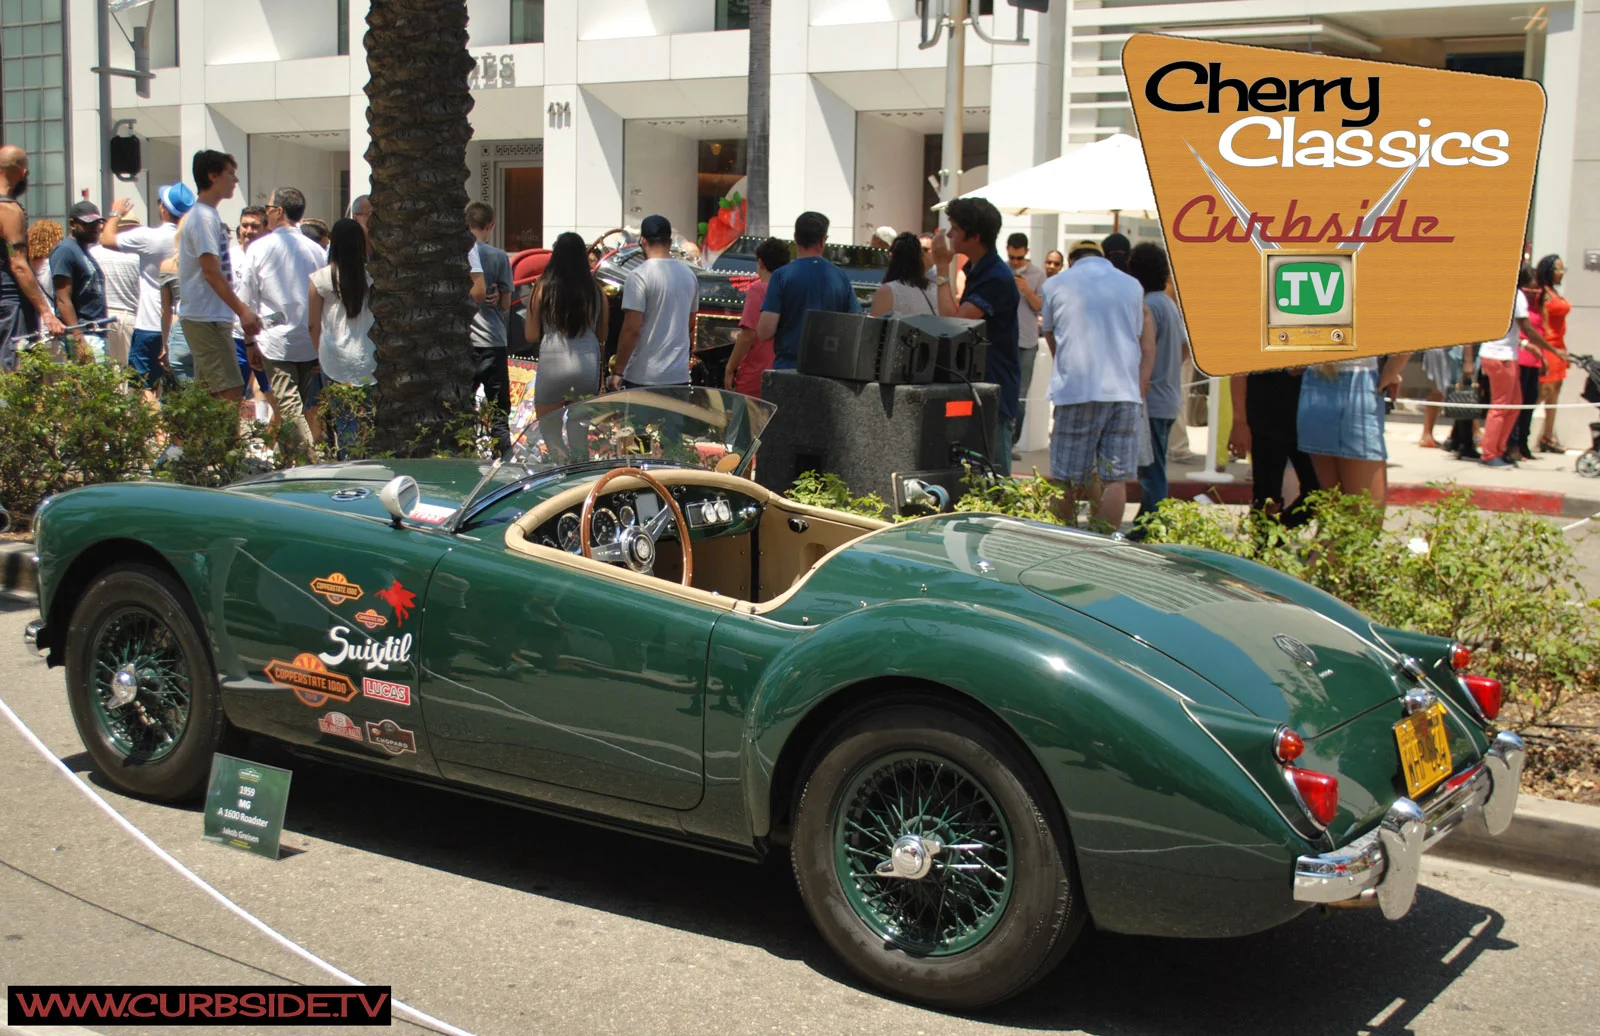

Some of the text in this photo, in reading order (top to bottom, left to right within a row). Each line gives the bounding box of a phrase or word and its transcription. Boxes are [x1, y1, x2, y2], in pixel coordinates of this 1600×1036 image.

[274, 667, 347, 694] COPPERSTATE 1000
[366, 680, 406, 701] LUCAS
[376, 737, 408, 749] CHOPARD
[239, 785, 256, 797] 1959
[238, 799, 252, 810] MG
[217, 807, 269, 828] A 1600 Roadster
